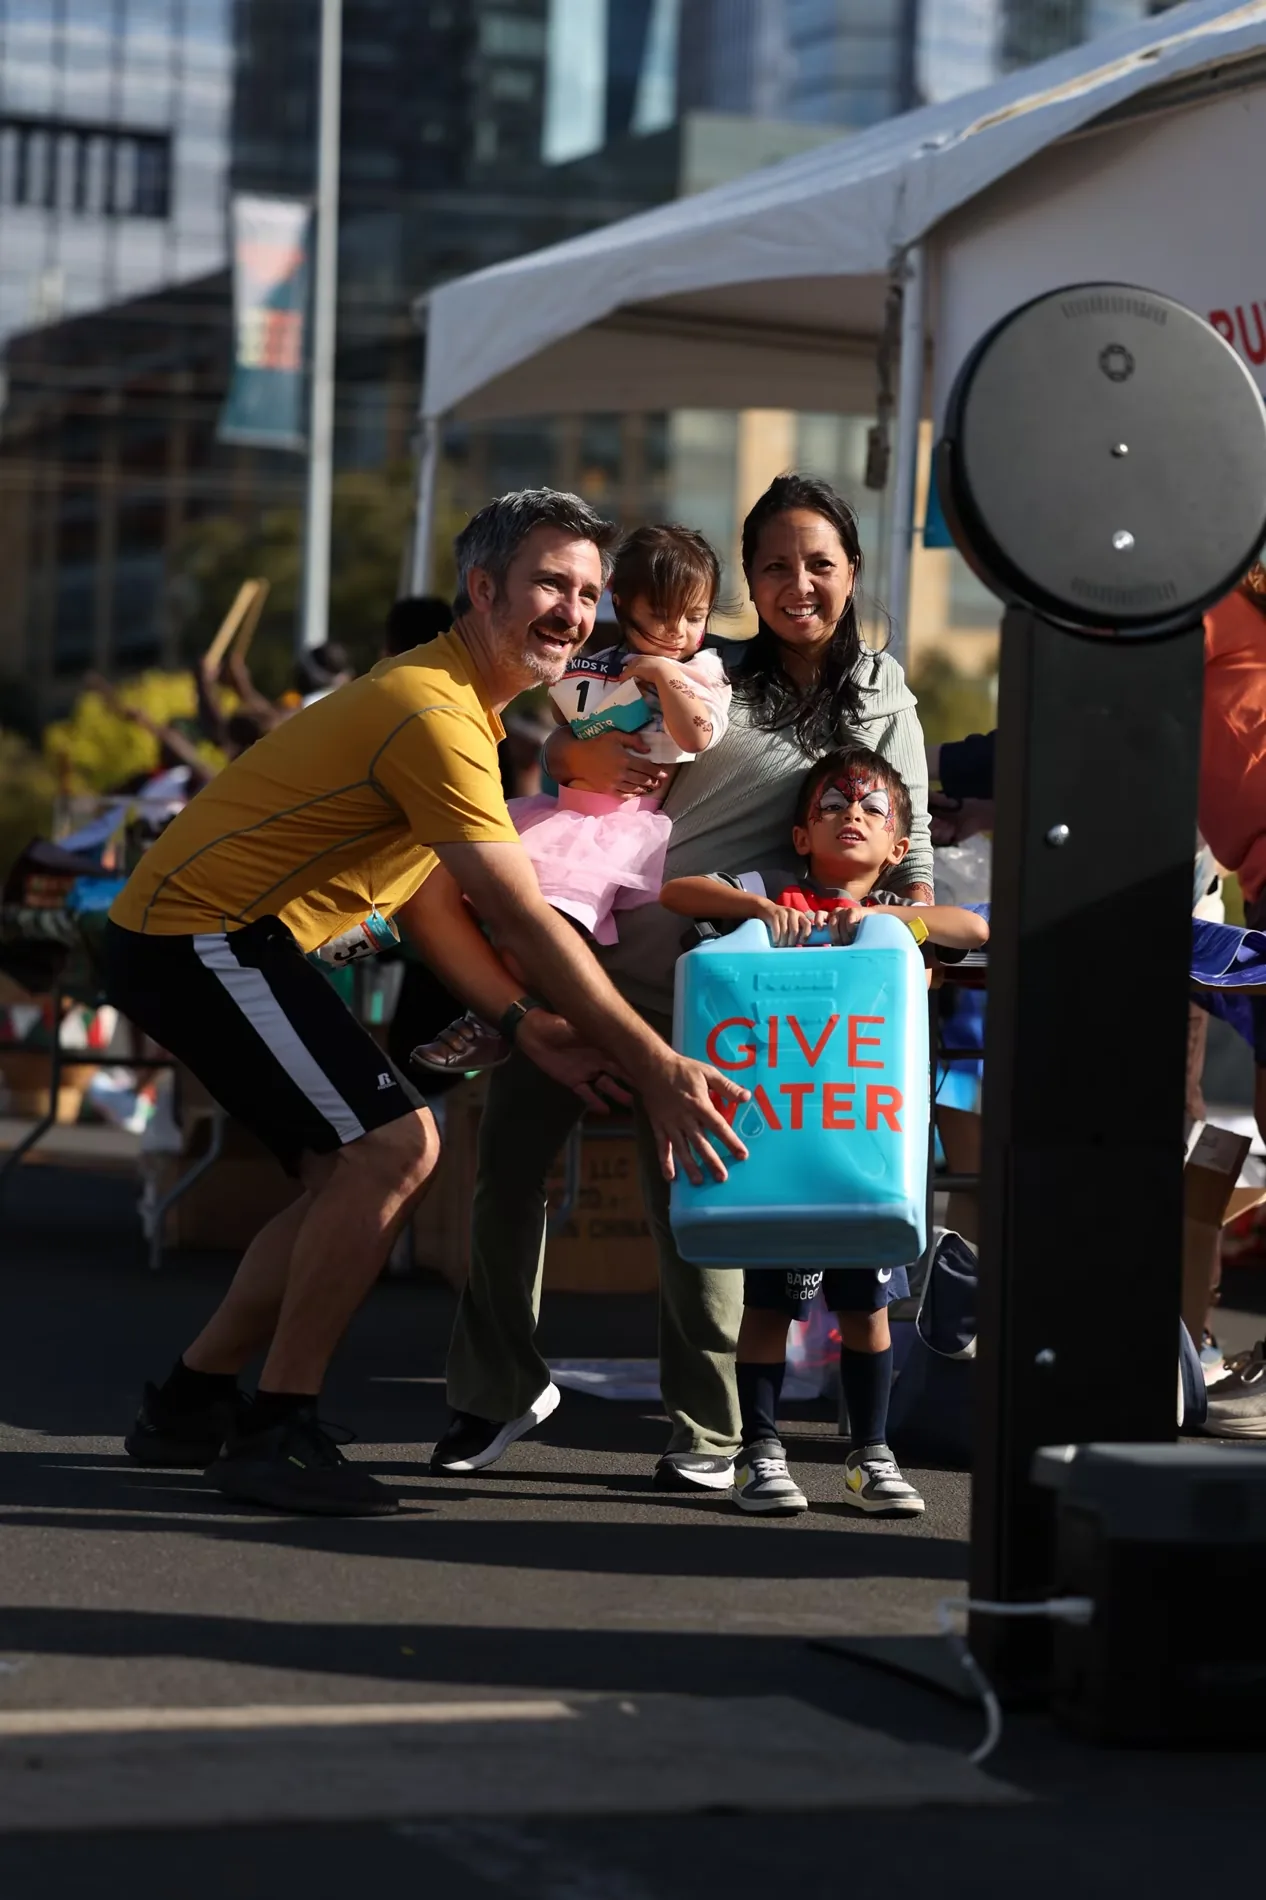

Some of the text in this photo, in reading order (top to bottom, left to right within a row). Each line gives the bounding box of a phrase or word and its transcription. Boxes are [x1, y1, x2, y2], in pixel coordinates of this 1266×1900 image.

[571, 658, 609, 673] KIDS K
[576, 680, 590, 713] 1
[583, 719, 616, 737] WATR
[706, 1014, 886, 1071] GIVE
